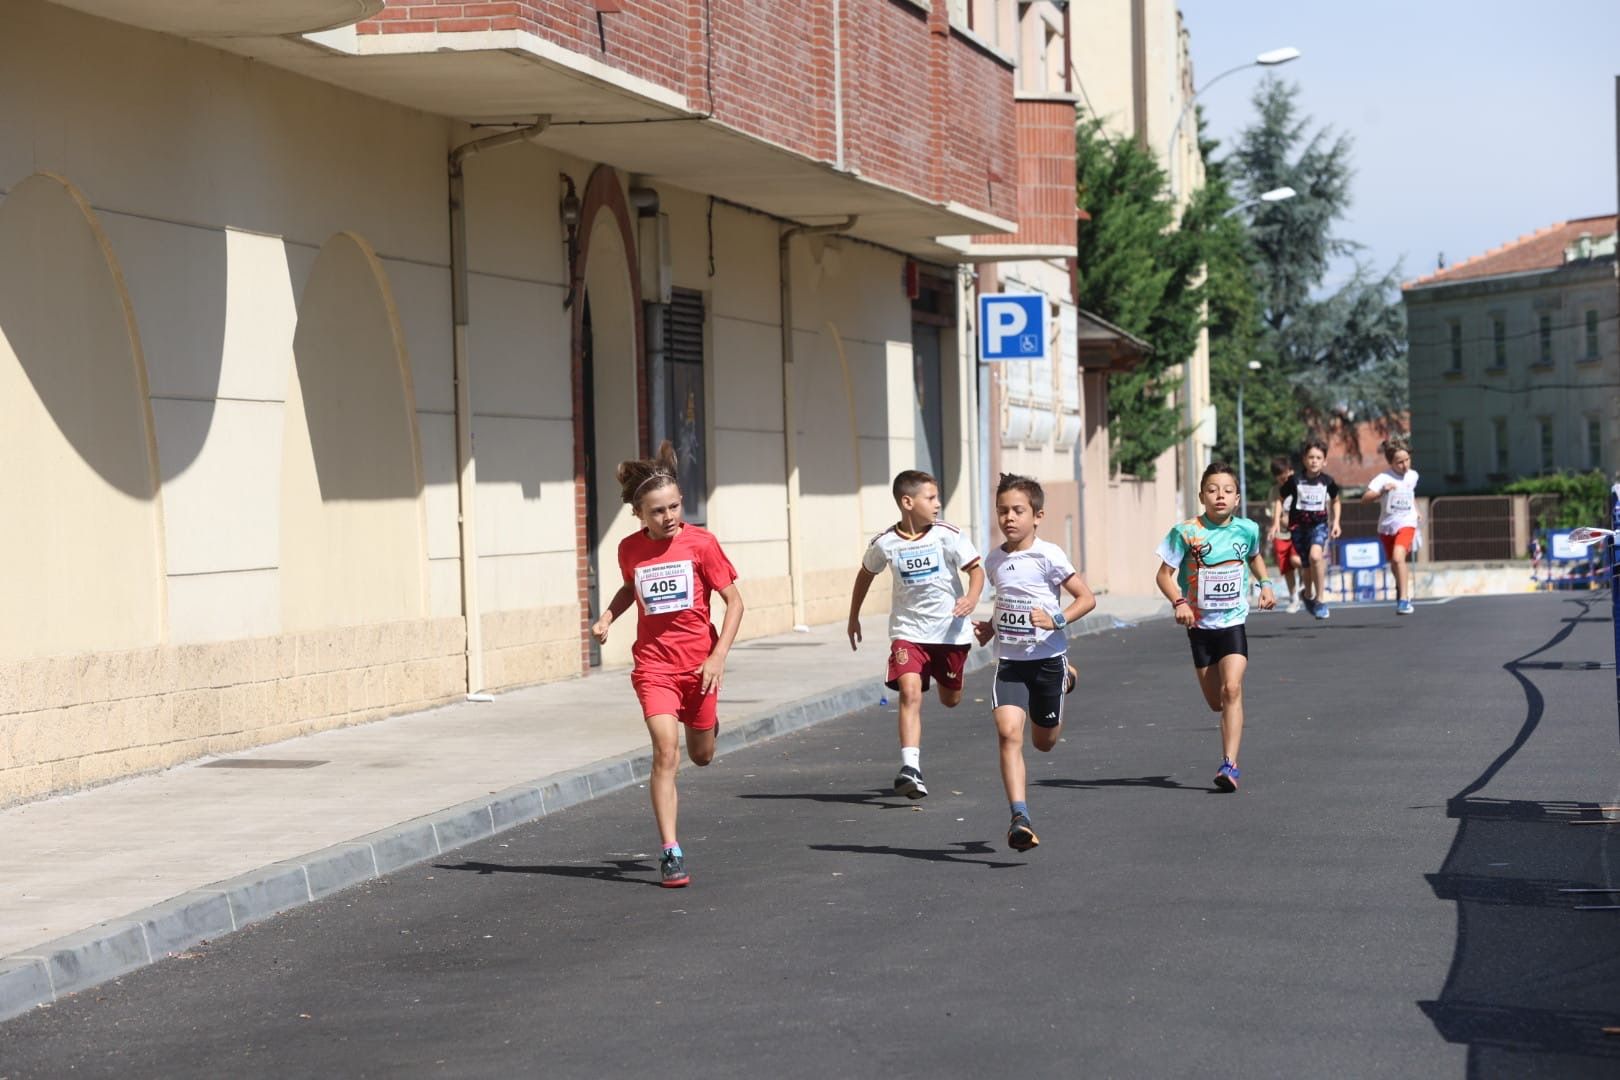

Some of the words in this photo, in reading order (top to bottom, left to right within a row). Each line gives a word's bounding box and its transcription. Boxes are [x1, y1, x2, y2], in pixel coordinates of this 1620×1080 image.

[987, 302, 1028, 354] P
[906, 557, 930, 570] 504
[650, 580, 677, 594] 405
[1213, 582, 1236, 593] 402
[1000, 612, 1026, 626] 404
